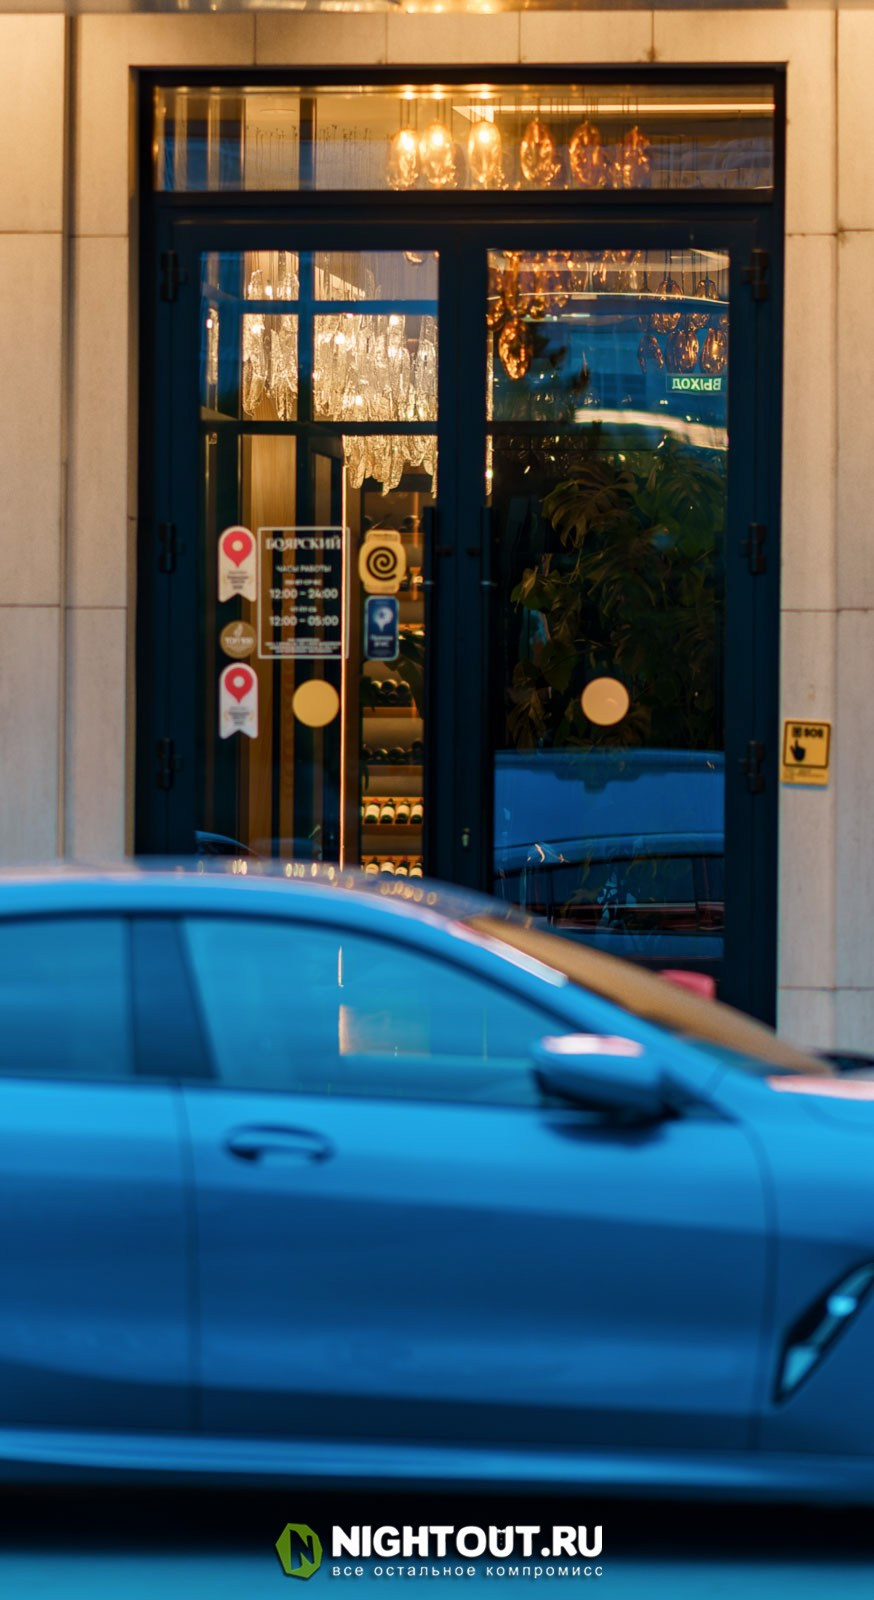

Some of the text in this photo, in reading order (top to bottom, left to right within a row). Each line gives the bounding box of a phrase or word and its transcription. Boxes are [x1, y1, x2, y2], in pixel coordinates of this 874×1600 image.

[266, 535, 341, 550] БОЯРСКИЙ
[276, 565, 331, 573] ЧАСЫ РАБОТЫ
[270, 588, 297, 599] 12:00
[308, 588, 338, 599] 24:00
[270, 615, 297, 626] 12:00
[308, 615, 339, 626] 05:00
